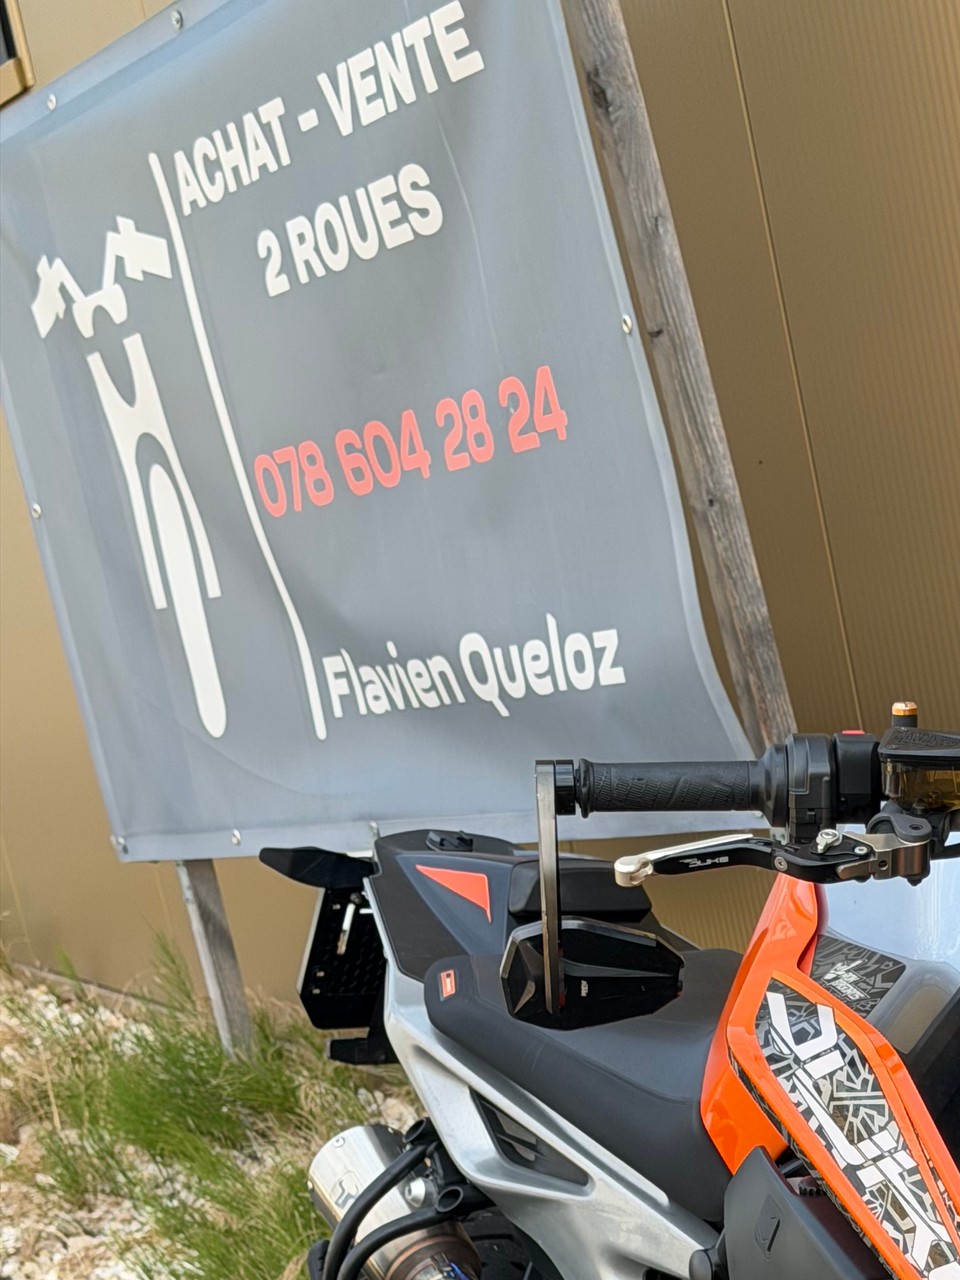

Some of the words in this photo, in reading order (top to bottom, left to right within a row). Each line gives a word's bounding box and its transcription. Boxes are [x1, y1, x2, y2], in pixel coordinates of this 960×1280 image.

[173, 96, 291, 217] ACHAT
[317, 0, 485, 137] VENTE
[256, 228, 291, 298] 2
[285, 163, 444, 286] ROUES
[253, 440, 334, 518] 078
[335, 410, 432, 497] 604
[435, 389, 495, 472] 28
[498, 365, 568, 454] 24
[322, 640, 466, 718] Flavien
[459, 612, 626, 717] Queloz
